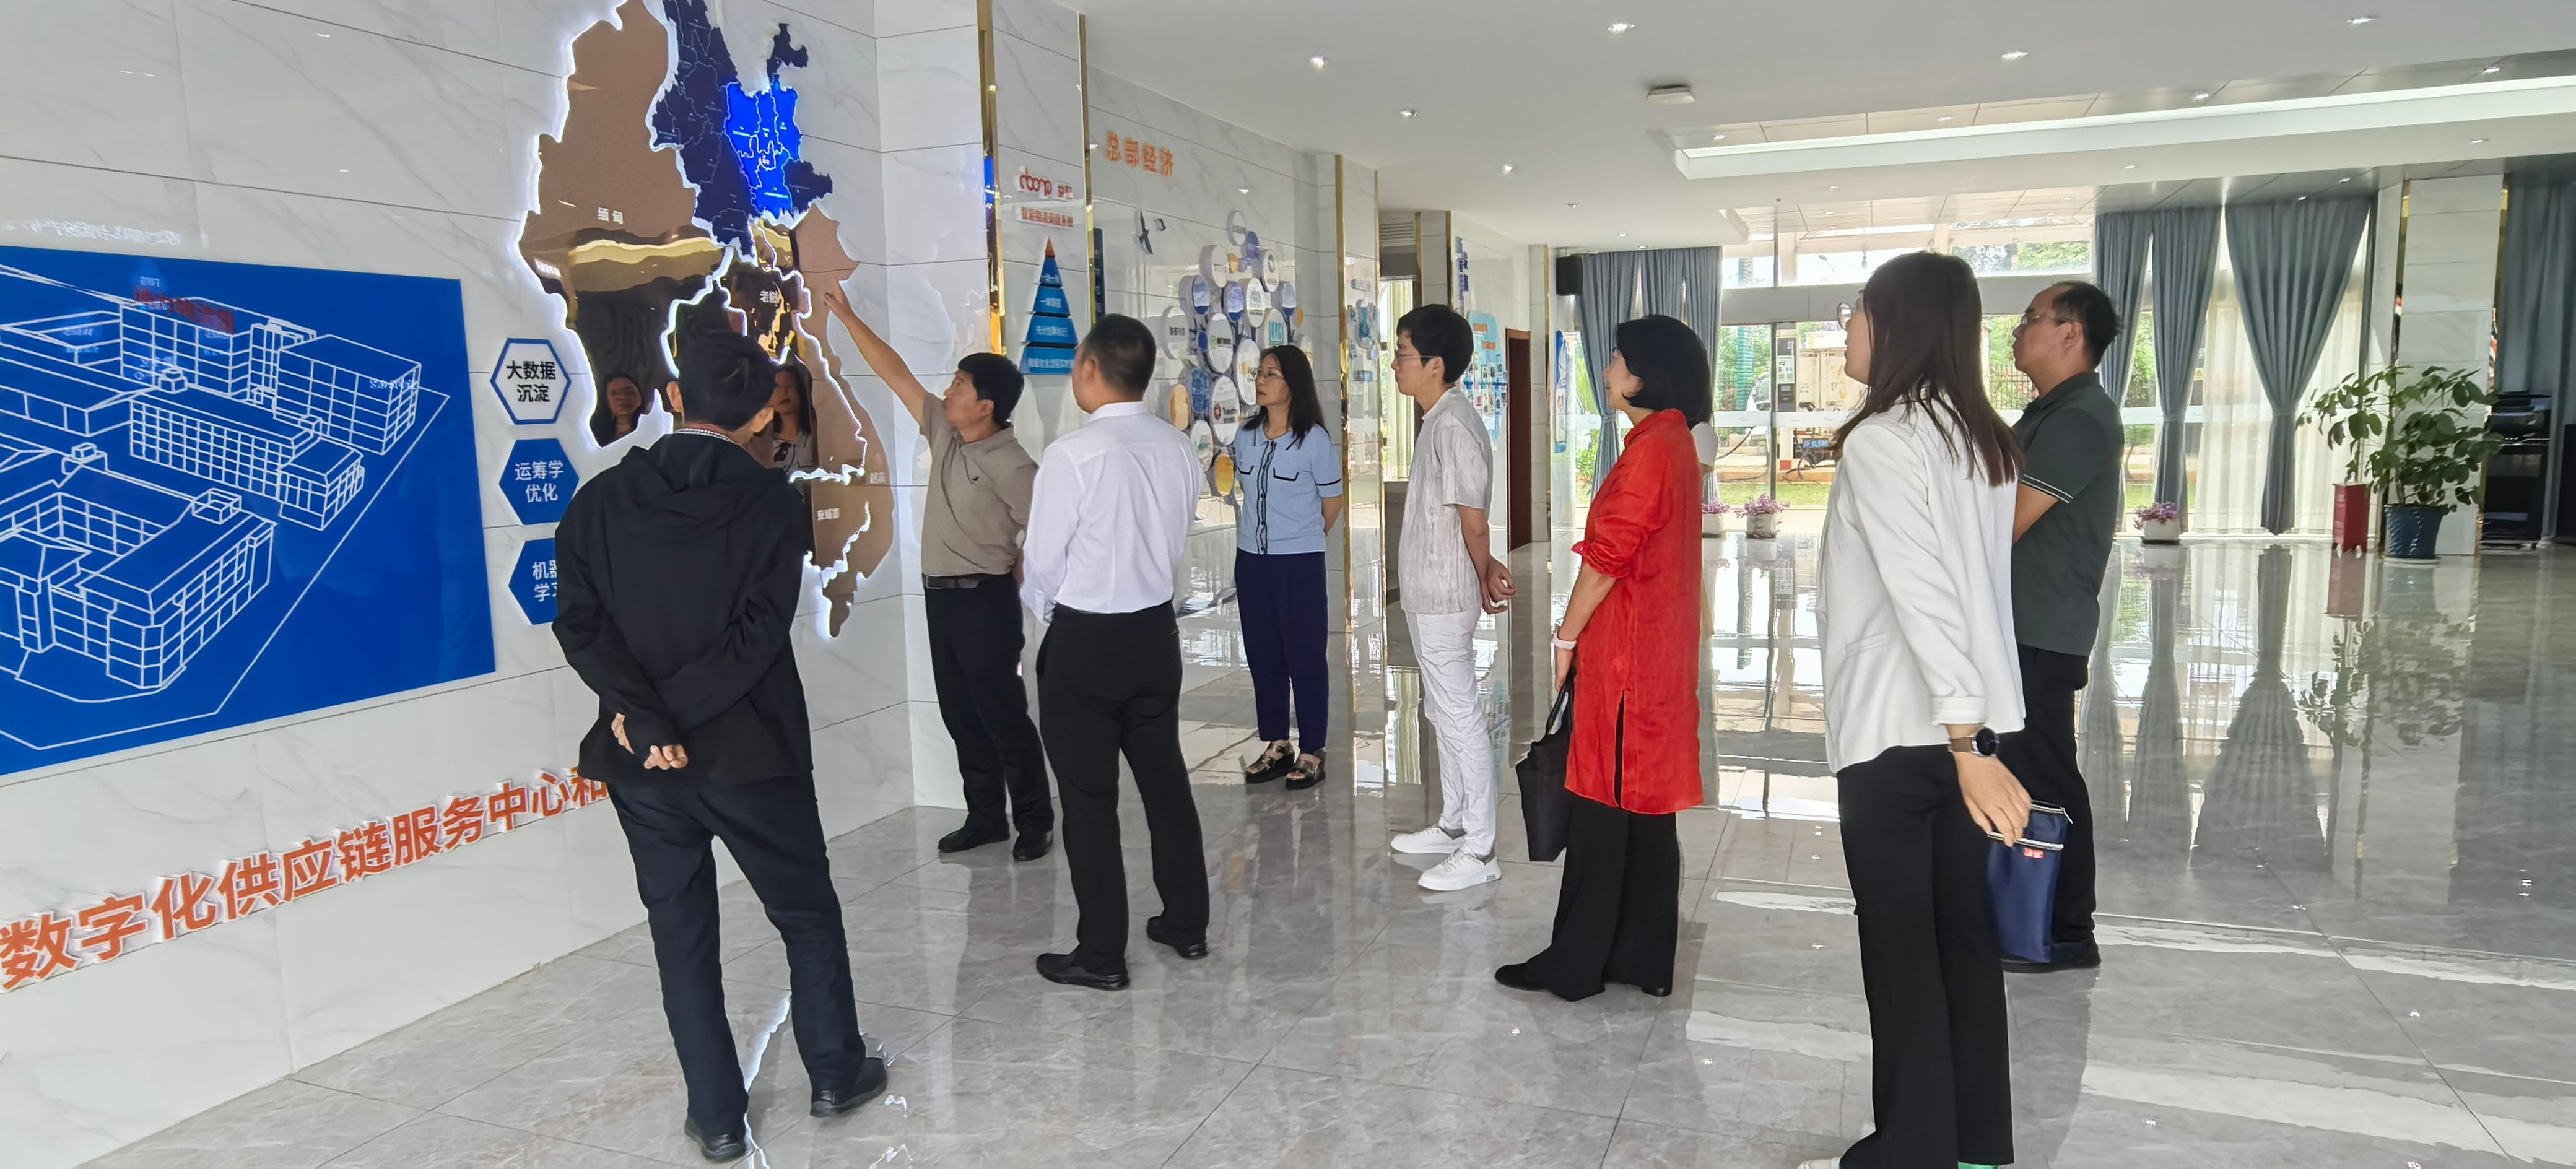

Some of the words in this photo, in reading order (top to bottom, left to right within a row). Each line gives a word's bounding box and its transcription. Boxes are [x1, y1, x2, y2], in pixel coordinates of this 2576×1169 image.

[1105, 131, 1174, 178] 总部经济
[597, 207, 624, 224] 缅甸
[506, 359, 557, 380] 大数据
[517, 383, 550, 402] 沉淀
[515, 460, 564, 481] 运筹学
[524, 483, 559, 503] 优化
